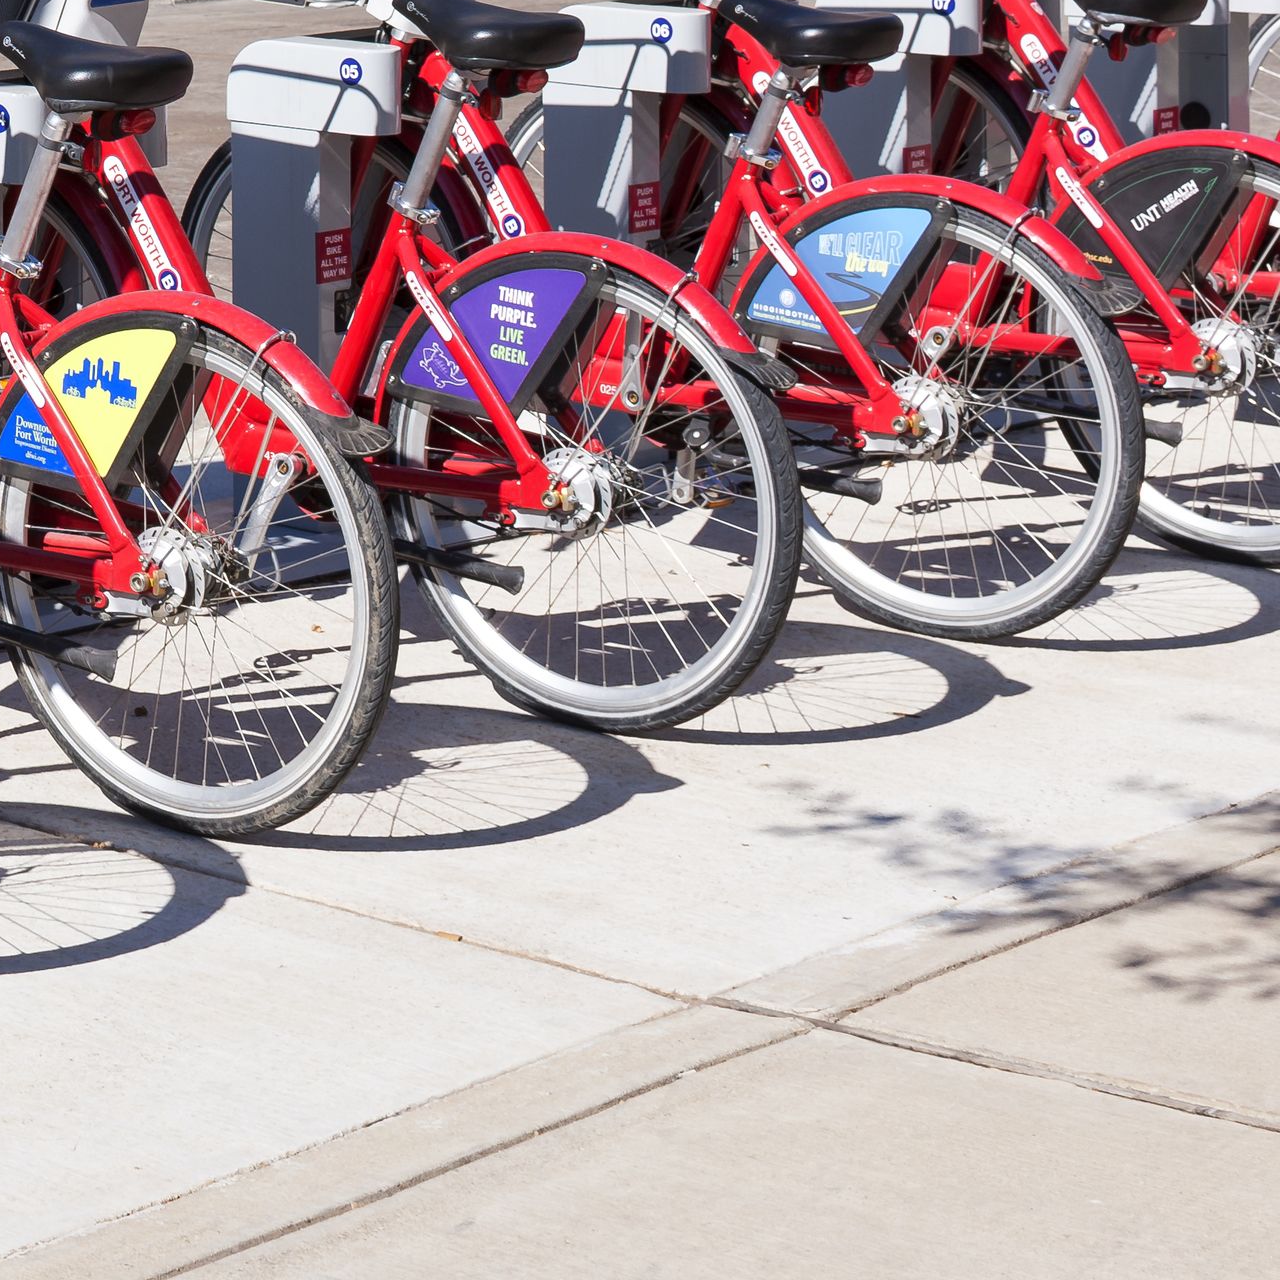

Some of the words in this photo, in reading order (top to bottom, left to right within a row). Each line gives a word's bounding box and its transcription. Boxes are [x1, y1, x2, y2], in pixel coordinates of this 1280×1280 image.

[652, 23, 670, 38] 06
[1026, 40, 1053, 76] FORT
[341, 64, 359, 79] 05
[779, 116, 814, 171] WORTH
[911, 150, 926, 159] PUSH
[474, 155, 507, 214] WORTH
[636, 187, 653, 196] PUSH
[638, 197, 652, 207] BIKE
[1130, 203, 1162, 232] UNT
[1159, 179, 1198, 209] HEALTH
[108, 163, 136, 209] FORT
[131, 205, 165, 269] WORTH
[633, 209, 644, 218] ALL
[645, 207, 657, 216] THE
[635, 220, 647, 228] WAY
[648, 218, 656, 226] IN
[324, 234, 343, 245] PUSH
[844, 230, 903, 266] CLEAR
[326, 245, 342, 255] BIKE
[320, 258, 334, 268] ALL
[334, 255, 348, 265] THE
[844, 251, 866, 273] the
[322, 268, 337, 279] WAY
[338, 267, 346, 276] IN
[498, 285, 535, 308] THINK
[490, 303, 537, 329] PURPLE.
[499, 325, 524, 346] LIVE
[490, 343, 529, 367] GREEN.
[15, 427, 32, 442] Fort
[32, 429, 58, 447] Worth
